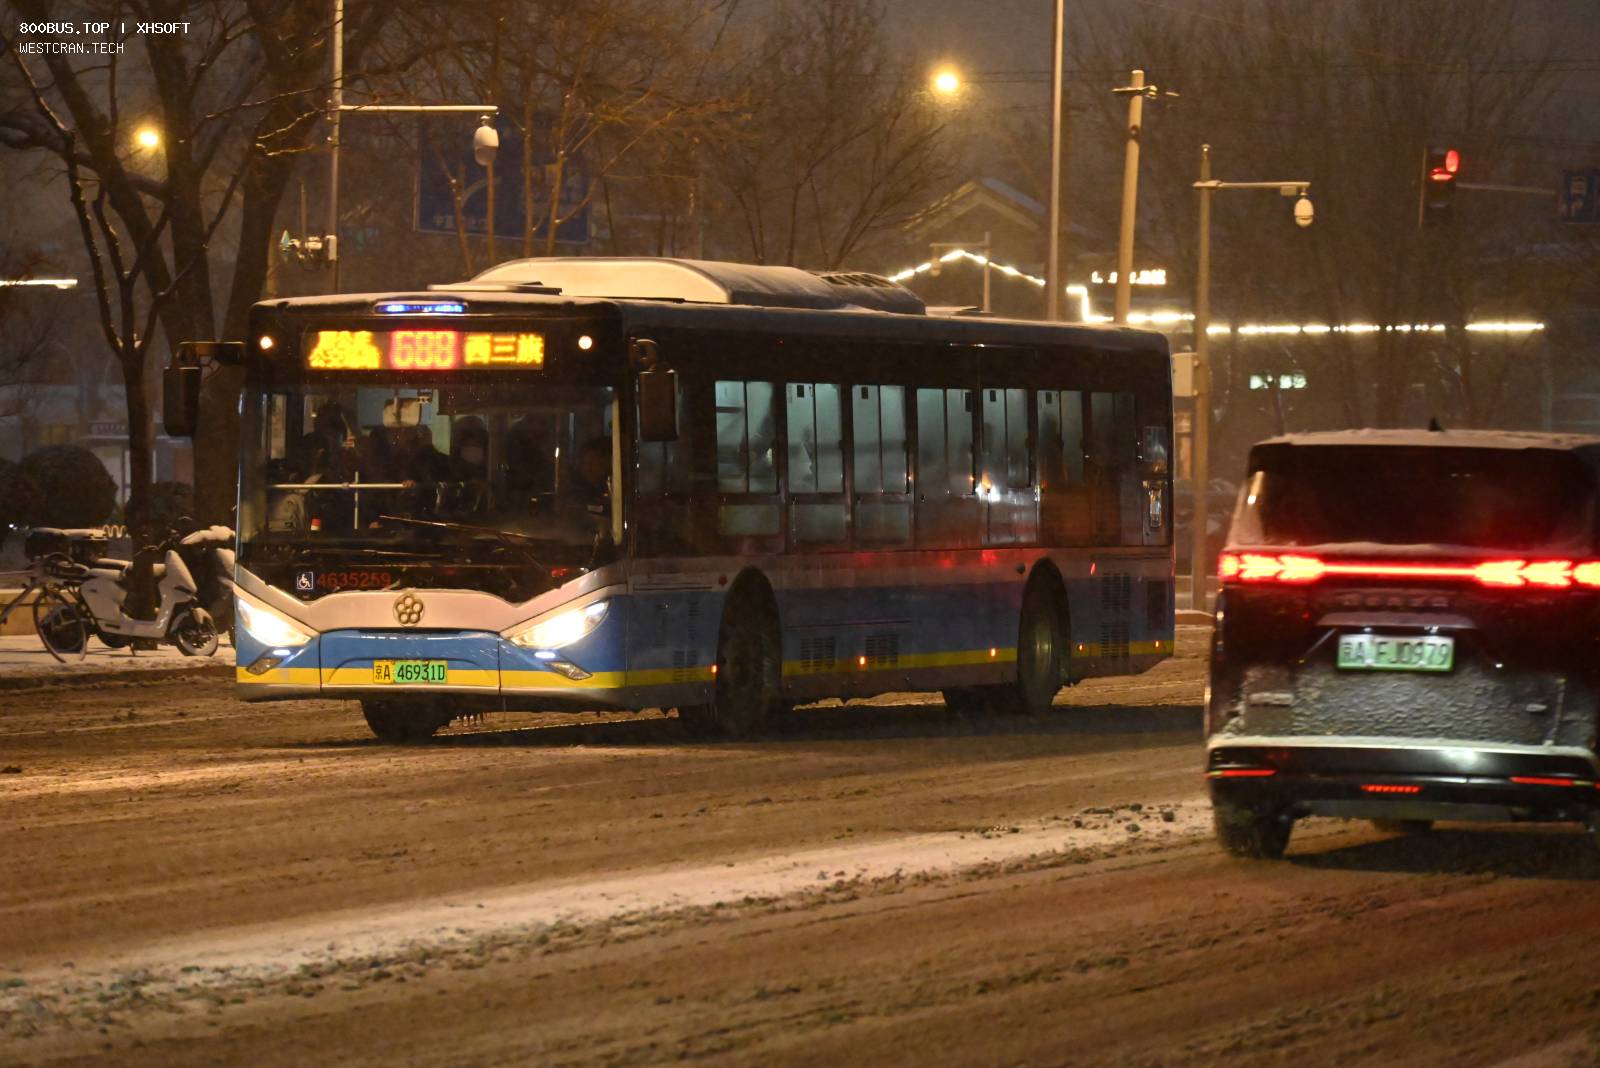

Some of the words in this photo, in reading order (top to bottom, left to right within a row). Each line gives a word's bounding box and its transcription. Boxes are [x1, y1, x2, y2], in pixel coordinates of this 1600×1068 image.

[394, 330, 457, 369] 688
[318, 572, 392, 588] 4635259
[375, 665, 391, 681] 京A
[397, 664, 446, 681] 46931D
